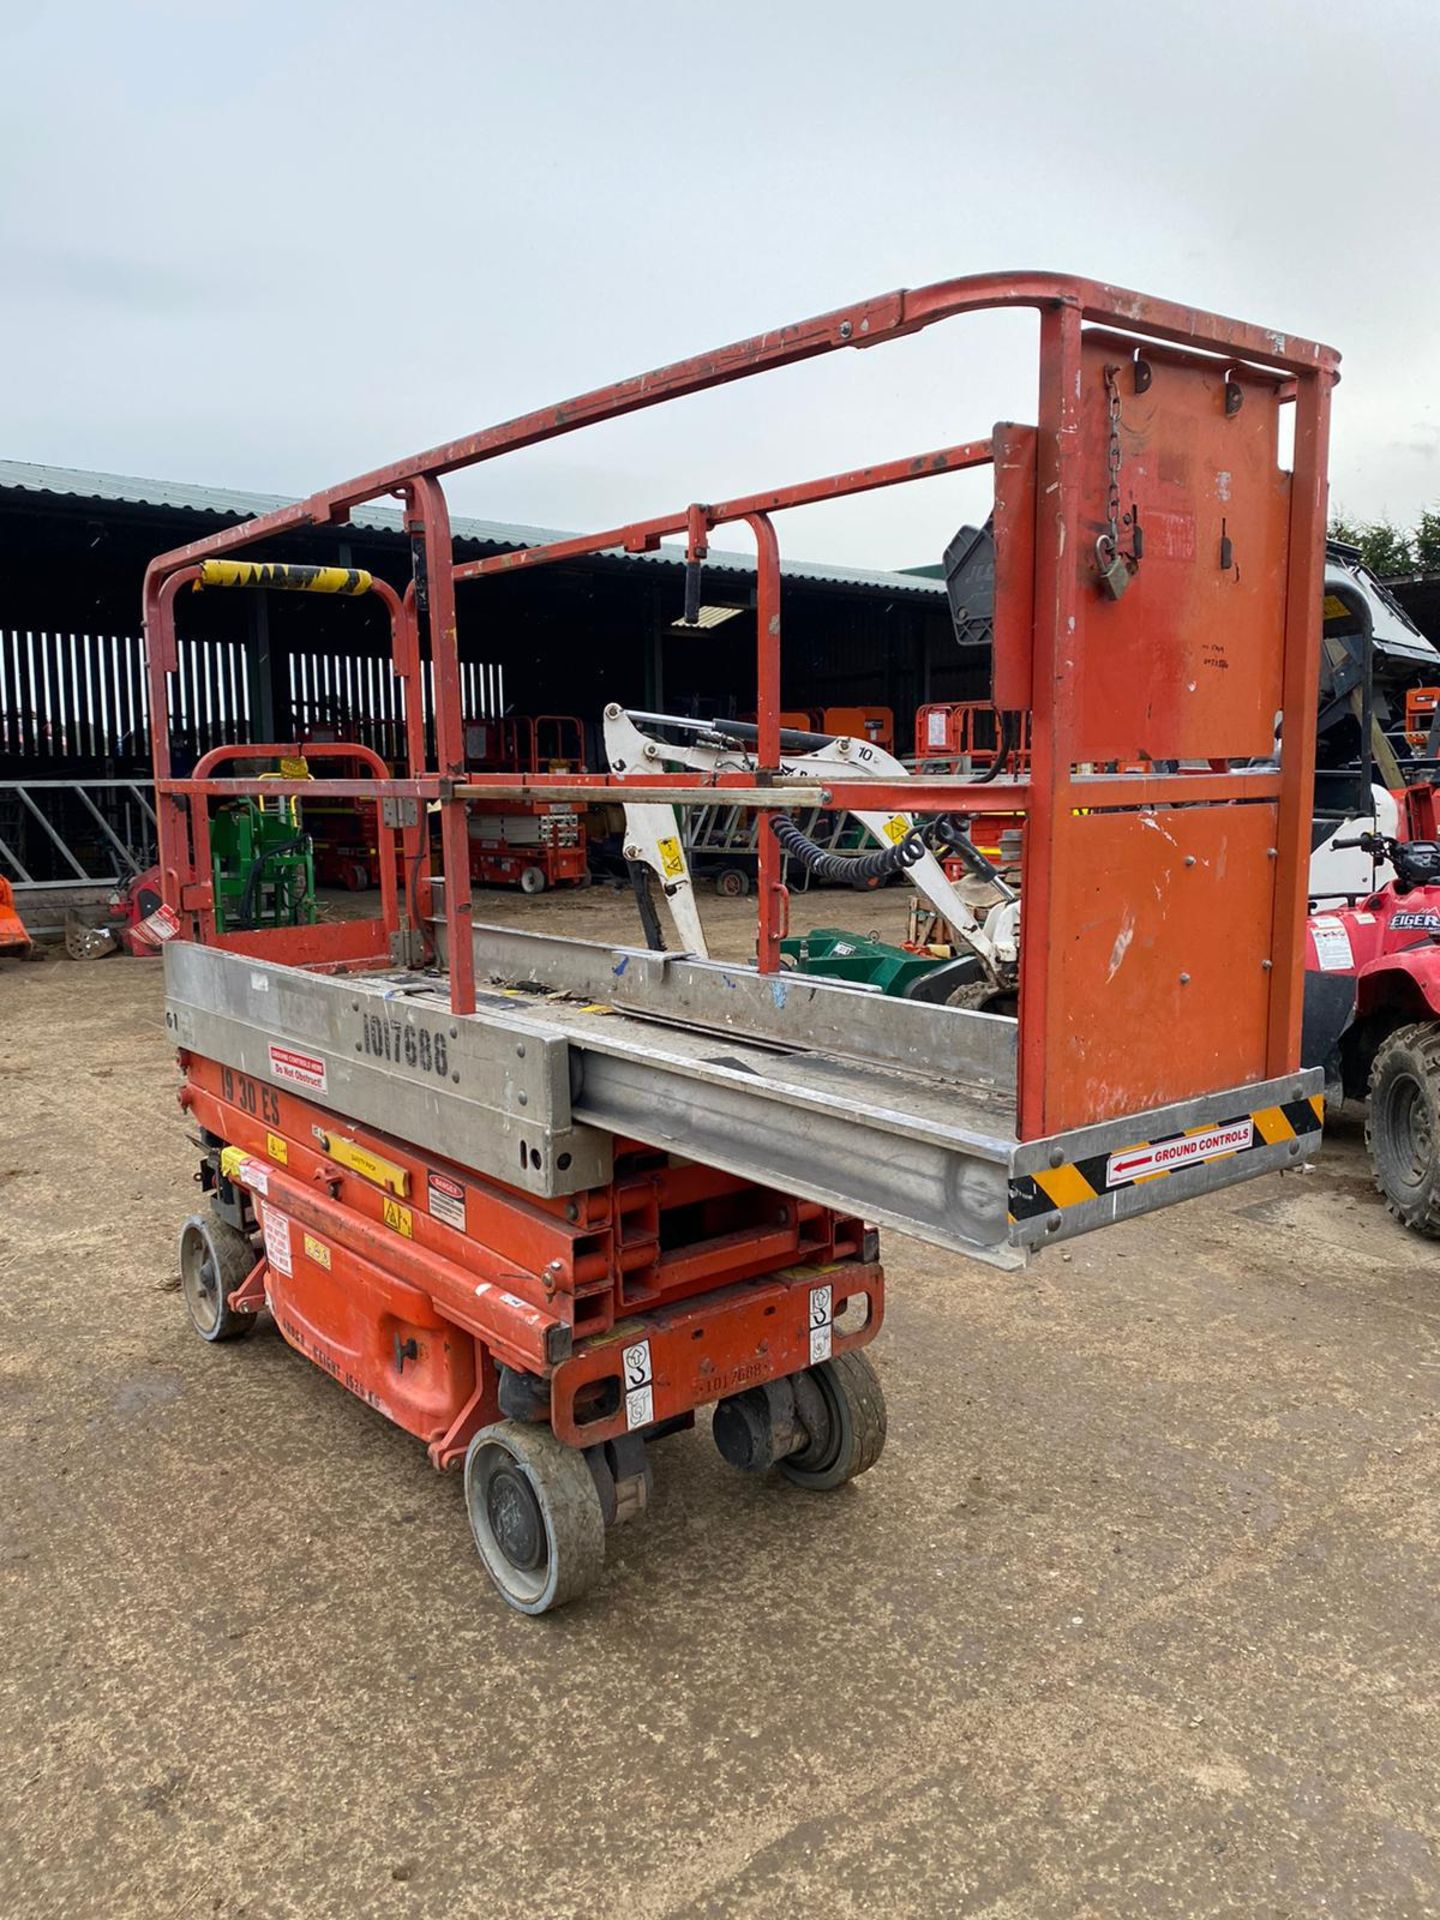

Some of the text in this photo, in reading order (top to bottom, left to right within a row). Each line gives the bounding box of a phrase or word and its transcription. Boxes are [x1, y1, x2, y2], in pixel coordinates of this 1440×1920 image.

[858, 746, 873, 761] 10
[1390, 913, 1440, 927] EIGER
[239, 1075, 256, 1114] 30
[261, 1086, 280, 1126] ES
[1154, 1128, 1249, 1162] GROUND CONTROLS
